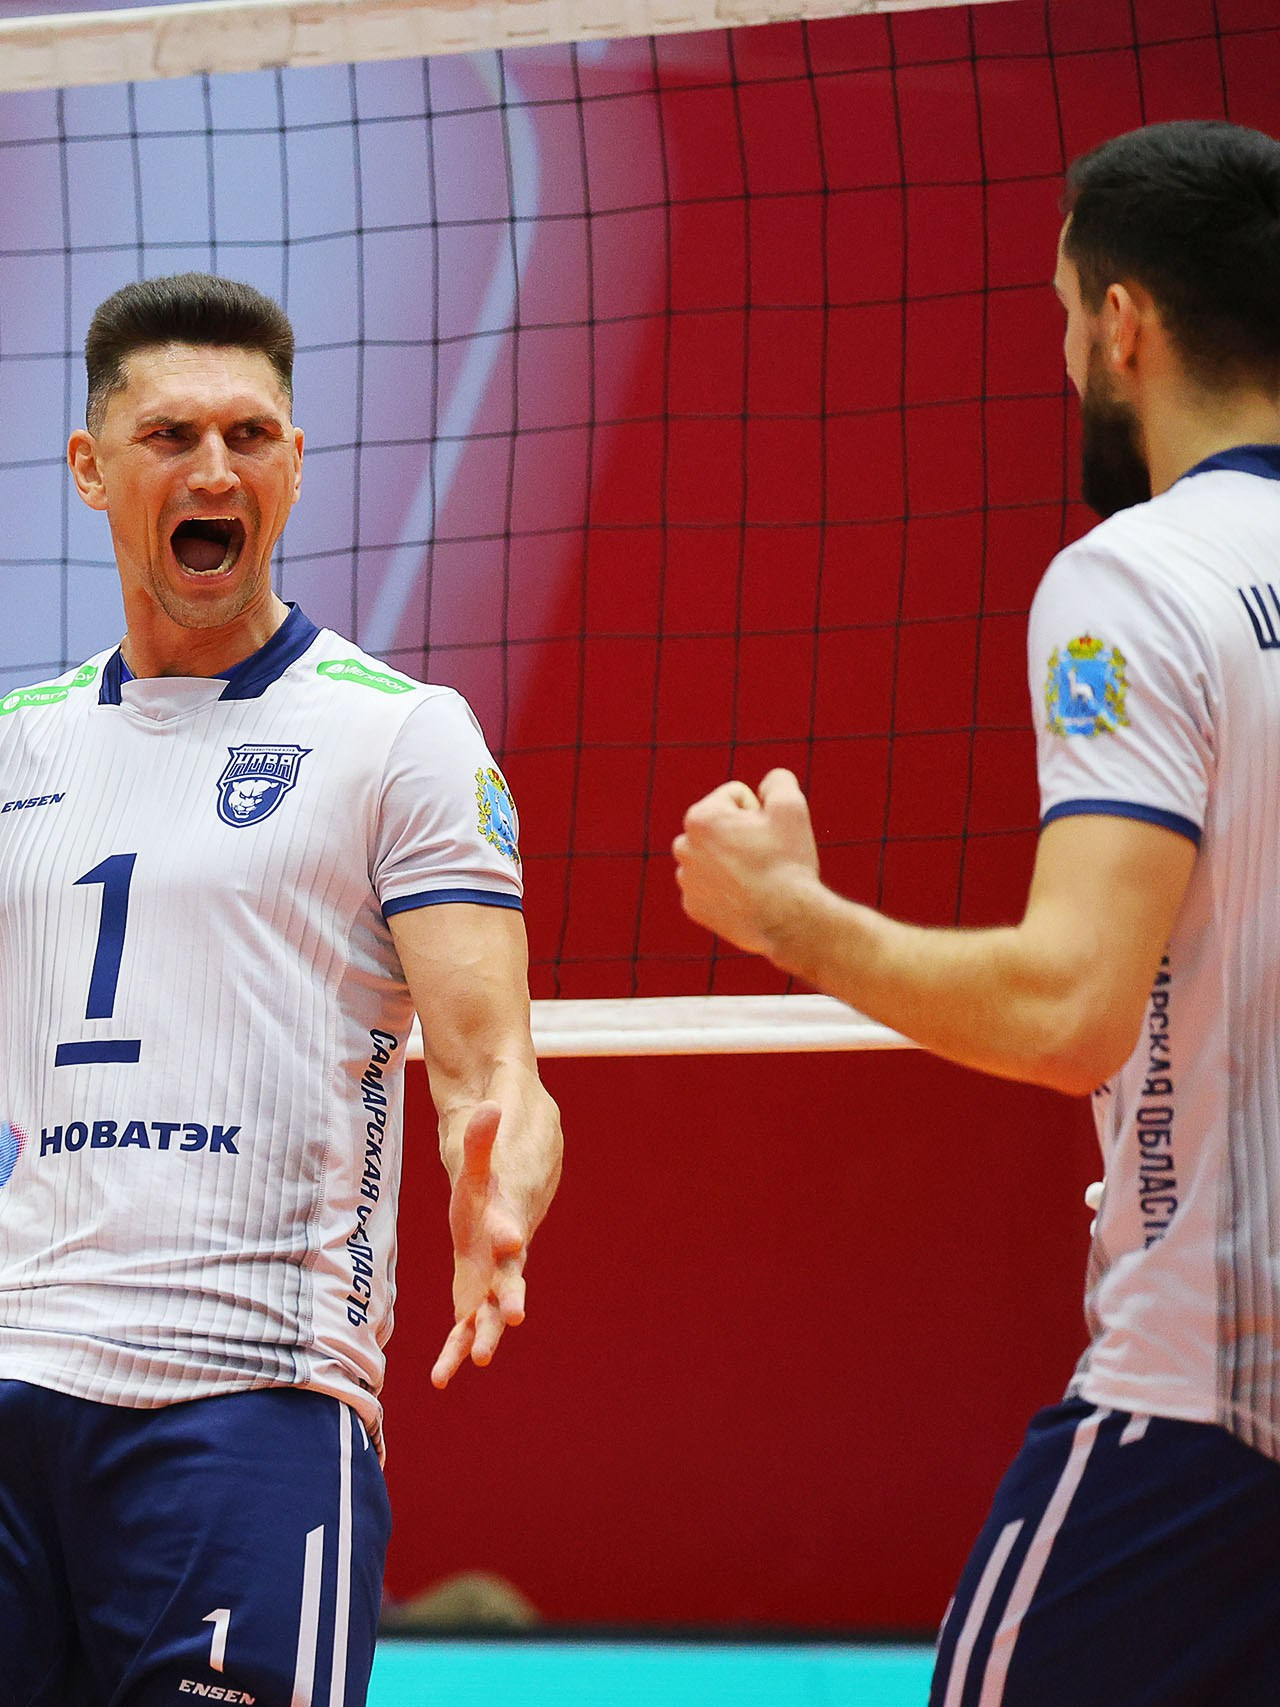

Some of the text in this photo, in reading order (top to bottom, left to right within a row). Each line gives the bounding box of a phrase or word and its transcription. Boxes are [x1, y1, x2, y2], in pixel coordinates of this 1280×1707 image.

[1, 792, 66, 814] ENSEN
[72, 853, 138, 1020] 1
[39, 1120, 242, 1157] НОВАТЭК
[360, 1028, 398, 1202] САМАРСКАЯ
[202, 1608, 231, 1673] 1
[178, 1679, 256, 1706] ENSEN
